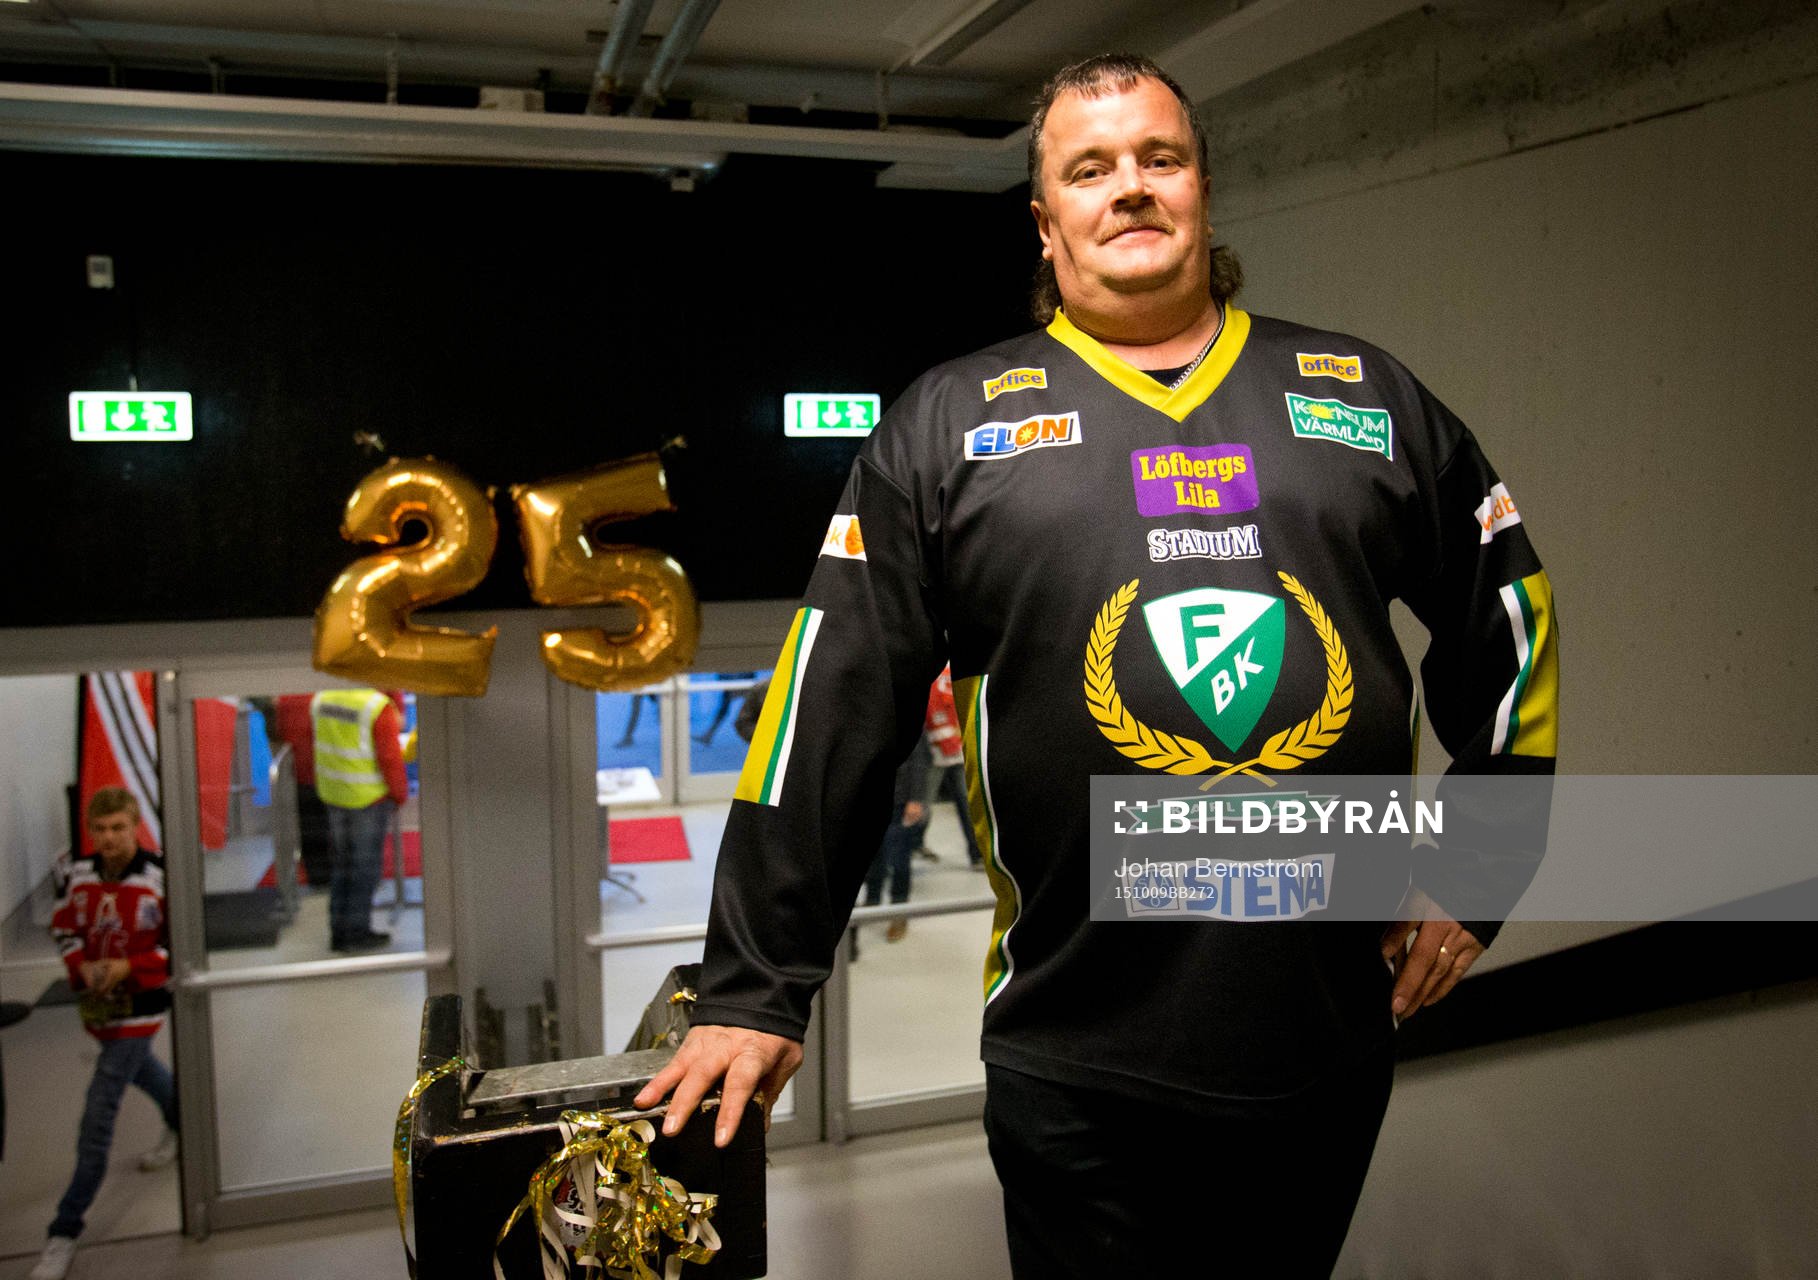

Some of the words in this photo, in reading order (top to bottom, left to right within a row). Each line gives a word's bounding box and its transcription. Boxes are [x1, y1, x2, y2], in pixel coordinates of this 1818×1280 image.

[1303, 358, 1357, 376] office
[990, 372, 1043, 395] office
[972, 417, 1074, 456] ELON
[1138, 451, 1248, 483] Löfbergs
[1174, 480, 1221, 509] Lila
[1147, 524, 1263, 562] STADIUM
[1183, 859, 1325, 918] STENA
